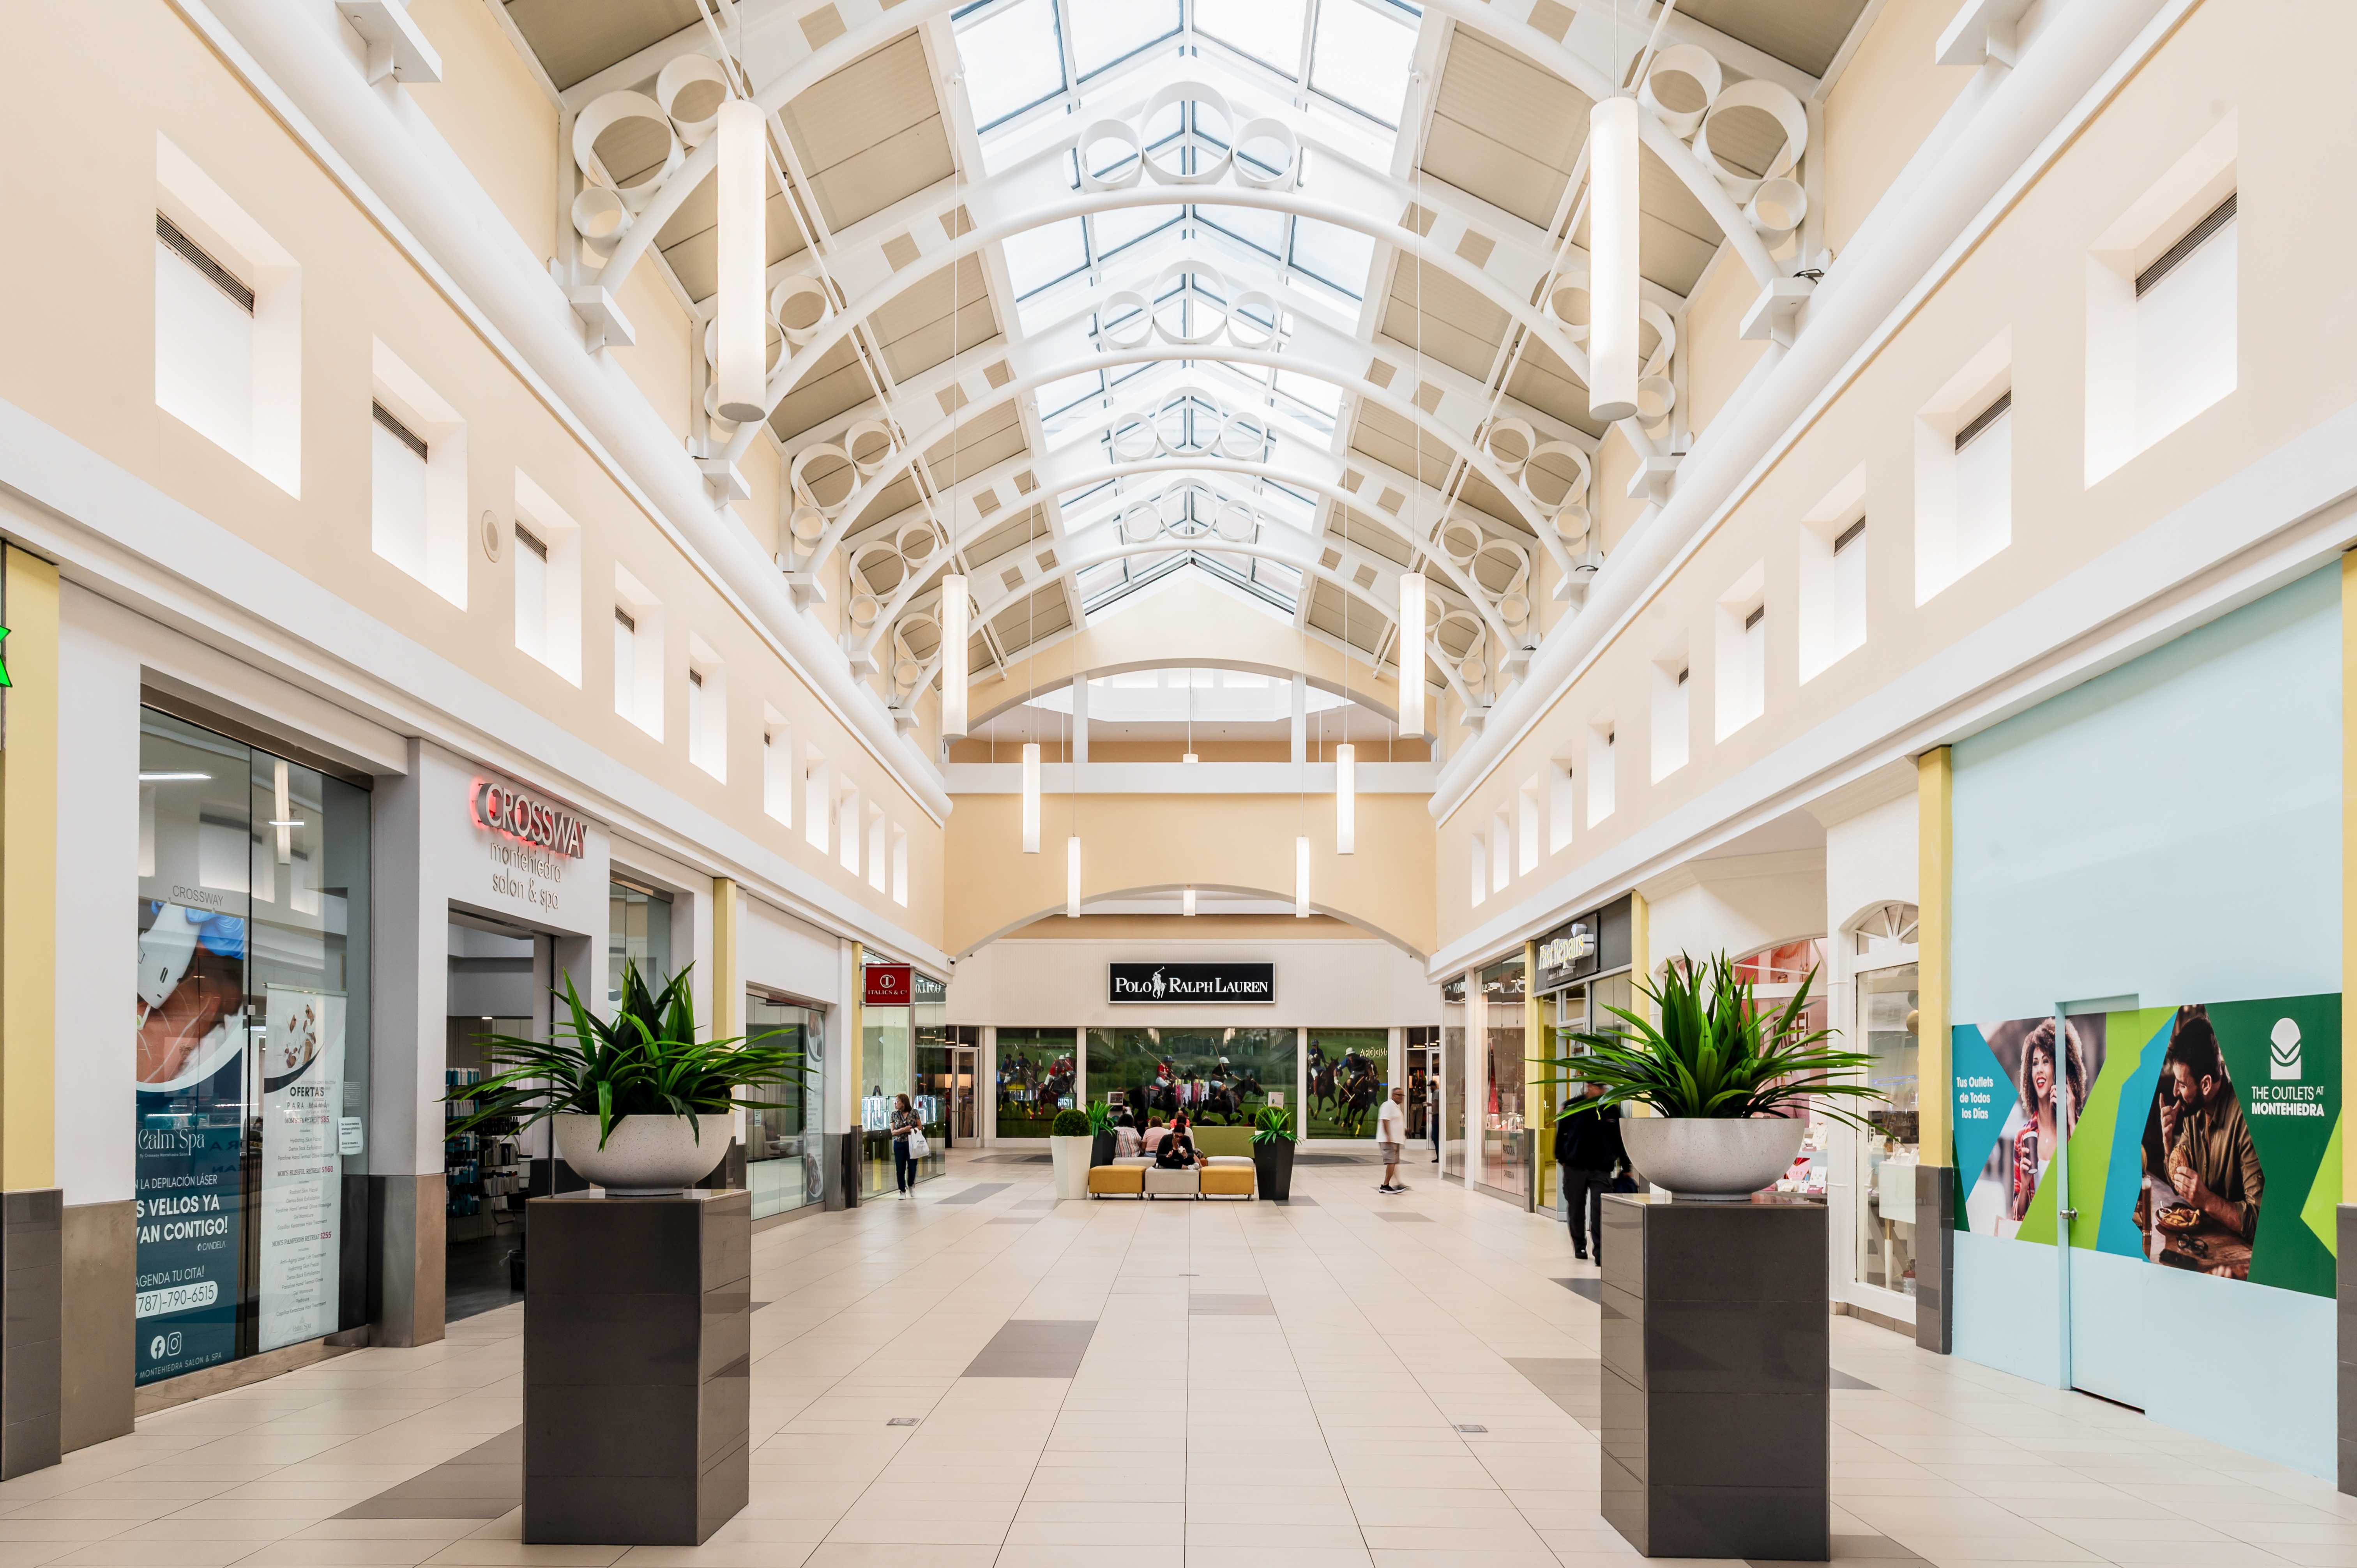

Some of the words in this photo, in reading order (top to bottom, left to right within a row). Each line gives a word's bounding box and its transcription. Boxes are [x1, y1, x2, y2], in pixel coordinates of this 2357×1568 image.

[478, 783, 589, 859] CROSSWAY
[491, 842, 562, 883] montehiedra
[173, 885, 223, 906] CROSSWAY
[493, 868, 525, 899] salon
[528, 878, 537, 903] &
[540, 888, 558, 913] spa
[1538, 941, 1553, 970] Fast
[1553, 934, 1584, 969] Repairs
[1115, 977, 1152, 992] POLO
[1169, 977, 1213, 992] RALPH
[1215, 977, 1268, 992] LAUREN
[1956, 1077, 1967, 1088] Tus
[1968, 1076, 1994, 1088] Outlets
[290, 1086, 324, 1097] OFERTAS
[1959, 1092, 1969, 1103] de
[1970, 1092, 1991, 1103] Todos
[2251, 1086, 2269, 1100] THE
[2272, 1086, 2314, 1100] OUTLETS
[2316, 1086, 2324, 1095] AT
[1961, 1108, 1972, 1119] los
[1973, 1107, 1989, 1119] Días
[2251, 1102, 2325, 1116] MONTEHIEDRA
[321, 1116, 330, 1124] $85
[138, 1129, 175, 1150] Calm
[179, 1128, 205, 1156] Spa
[141, 1178, 150, 1189] LA
[152, 1173, 195, 1188] DEPILACIÓN
[197, 1172, 217, 1186] LÁSER
[148, 1195, 199, 1216] VELLOS
[202, 1194, 220, 1211] YA
[164, 1215, 228, 1241] CONTIGO!
[320, 1231, 332, 1239] $255
[202, 1240, 226, 1251] CANDELA
[172, 1270, 182, 1282] TU
[184, 1265, 205, 1280] CITA!
[136, 1285, 214, 1314] 787)-790-6515
[139, 1362, 183, 1379] MONTEHIEDRA
[185, 1356, 204, 1367] SALON
[211, 1352, 222, 1360] SPA
